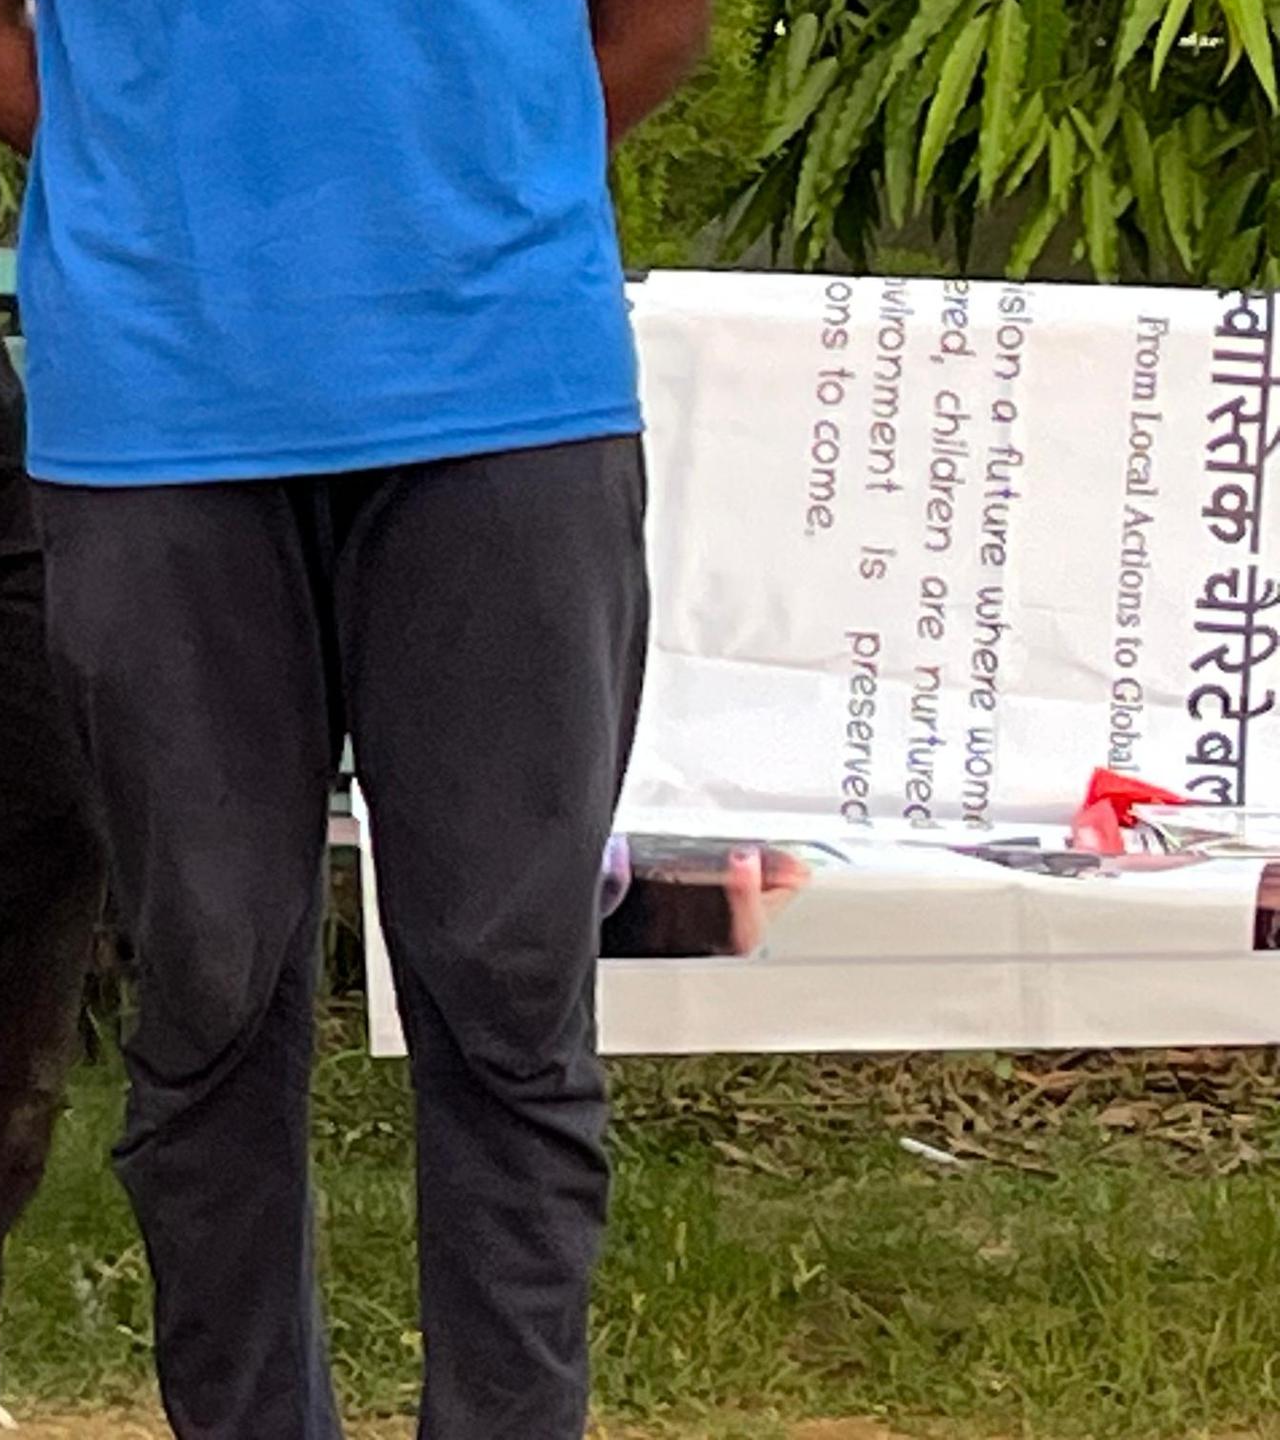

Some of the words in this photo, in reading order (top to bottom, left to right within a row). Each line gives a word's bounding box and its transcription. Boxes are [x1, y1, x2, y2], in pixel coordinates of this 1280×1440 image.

[993, 281, 1033, 380] ision
[1132, 315, 1169, 400] From
[817, 368, 855, 405] to
[991, 400, 1019, 422] a
[804, 420, 844, 537] come.
[923, 390, 970, 551] children
[1124, 412, 1162, 496] Local
[981, 445, 1024, 566] future
[859, 546, 895, 580] is
[917, 576, 951, 639] are
[1116, 504, 1155, 627] Actions
[970, 586, 1010, 710] where
[1114, 637, 1144, 667] to
[839, 631, 883, 827] preserved
[903, 665, 948, 828] nurtured
[1107, 677, 1143, 770] Global
